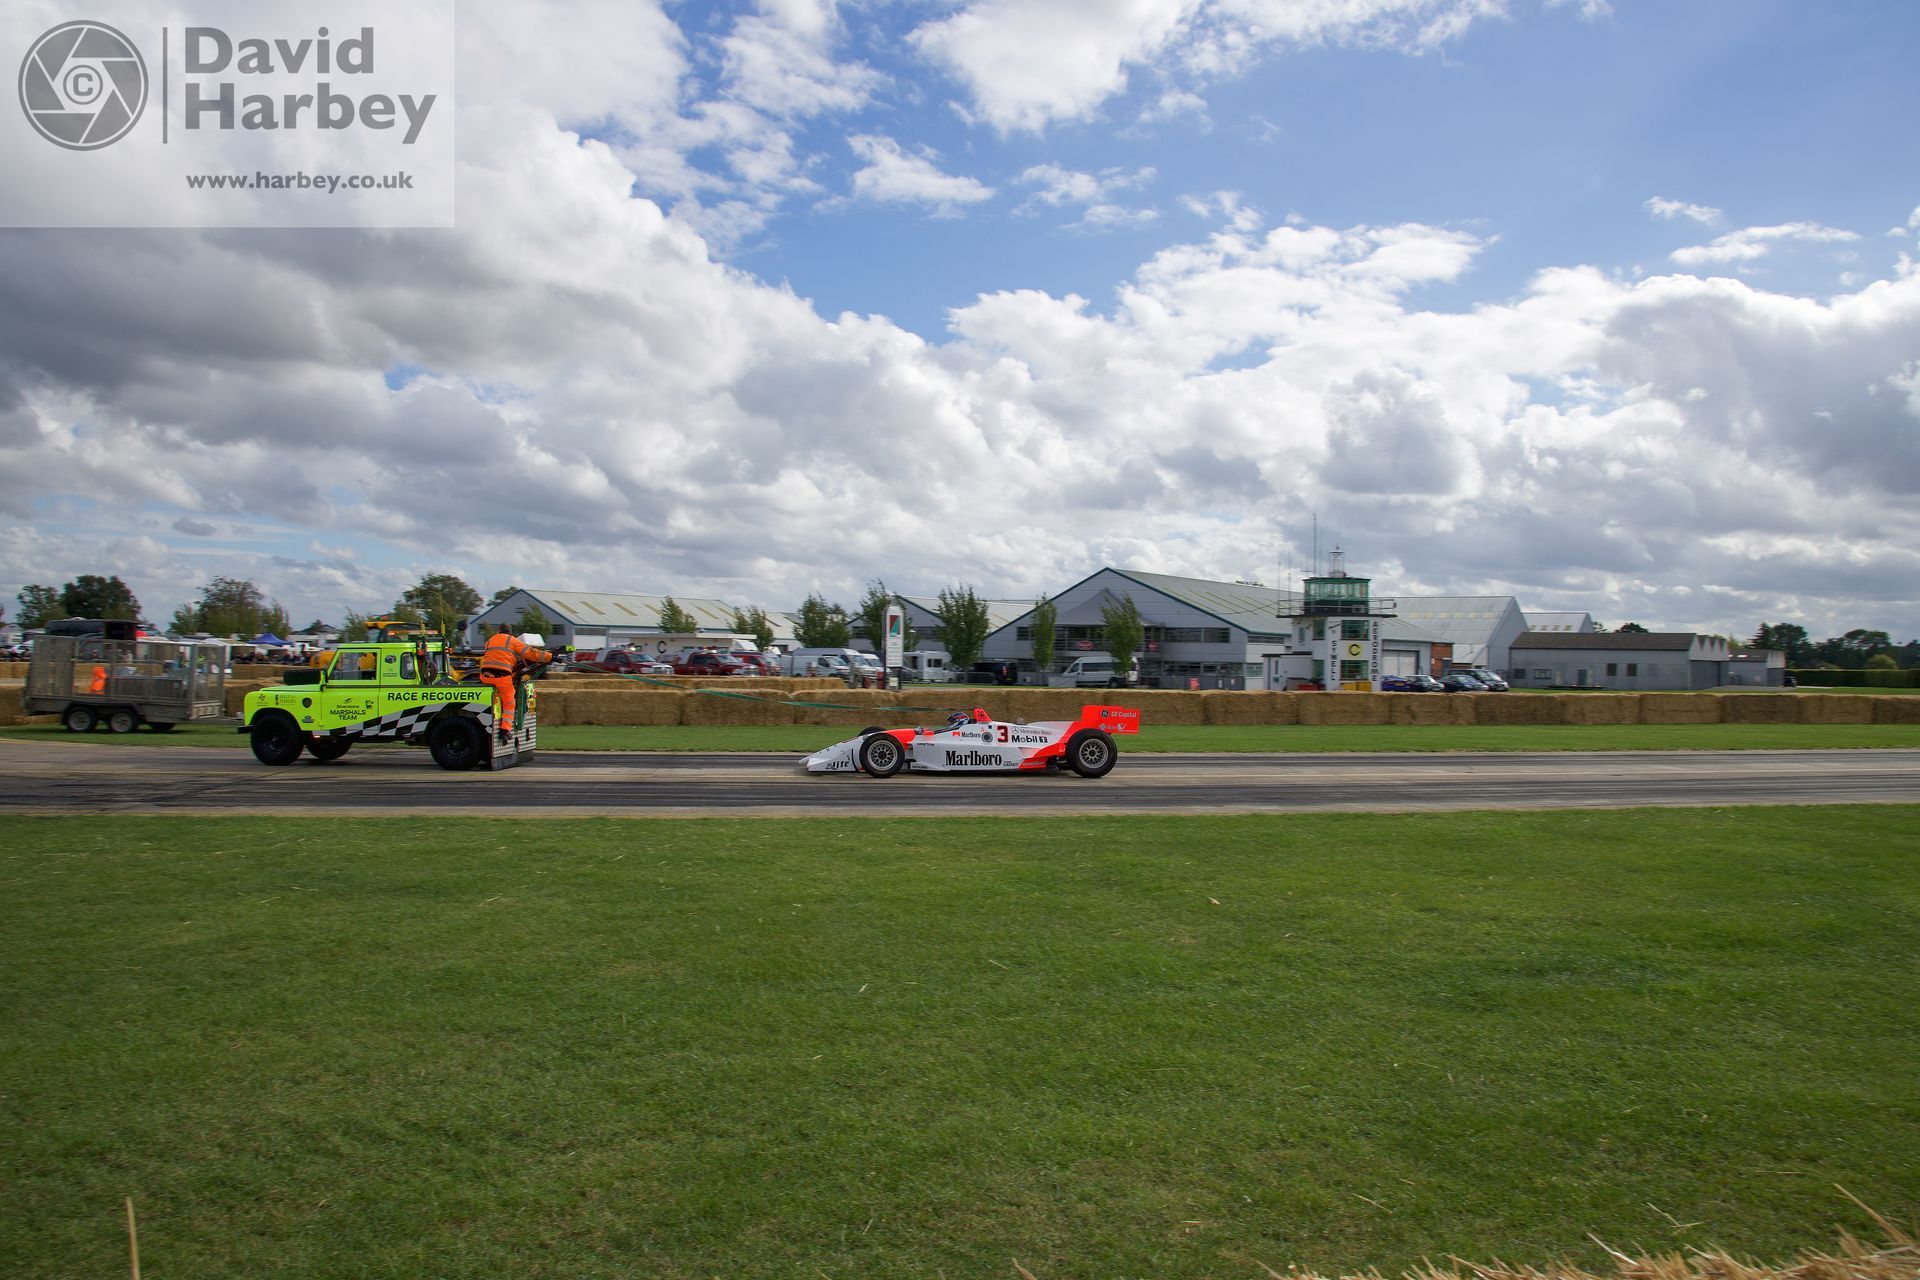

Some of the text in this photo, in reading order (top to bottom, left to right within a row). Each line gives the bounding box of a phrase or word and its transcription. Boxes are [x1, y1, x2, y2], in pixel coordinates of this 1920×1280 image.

[657, 640, 668, 653] C
[1349, 644, 1361, 656] C
[388, 692, 482, 700] RACE RECOVERY
[997, 726, 1008, 743] 3
[945, 750, 1002, 766] Marlboro
